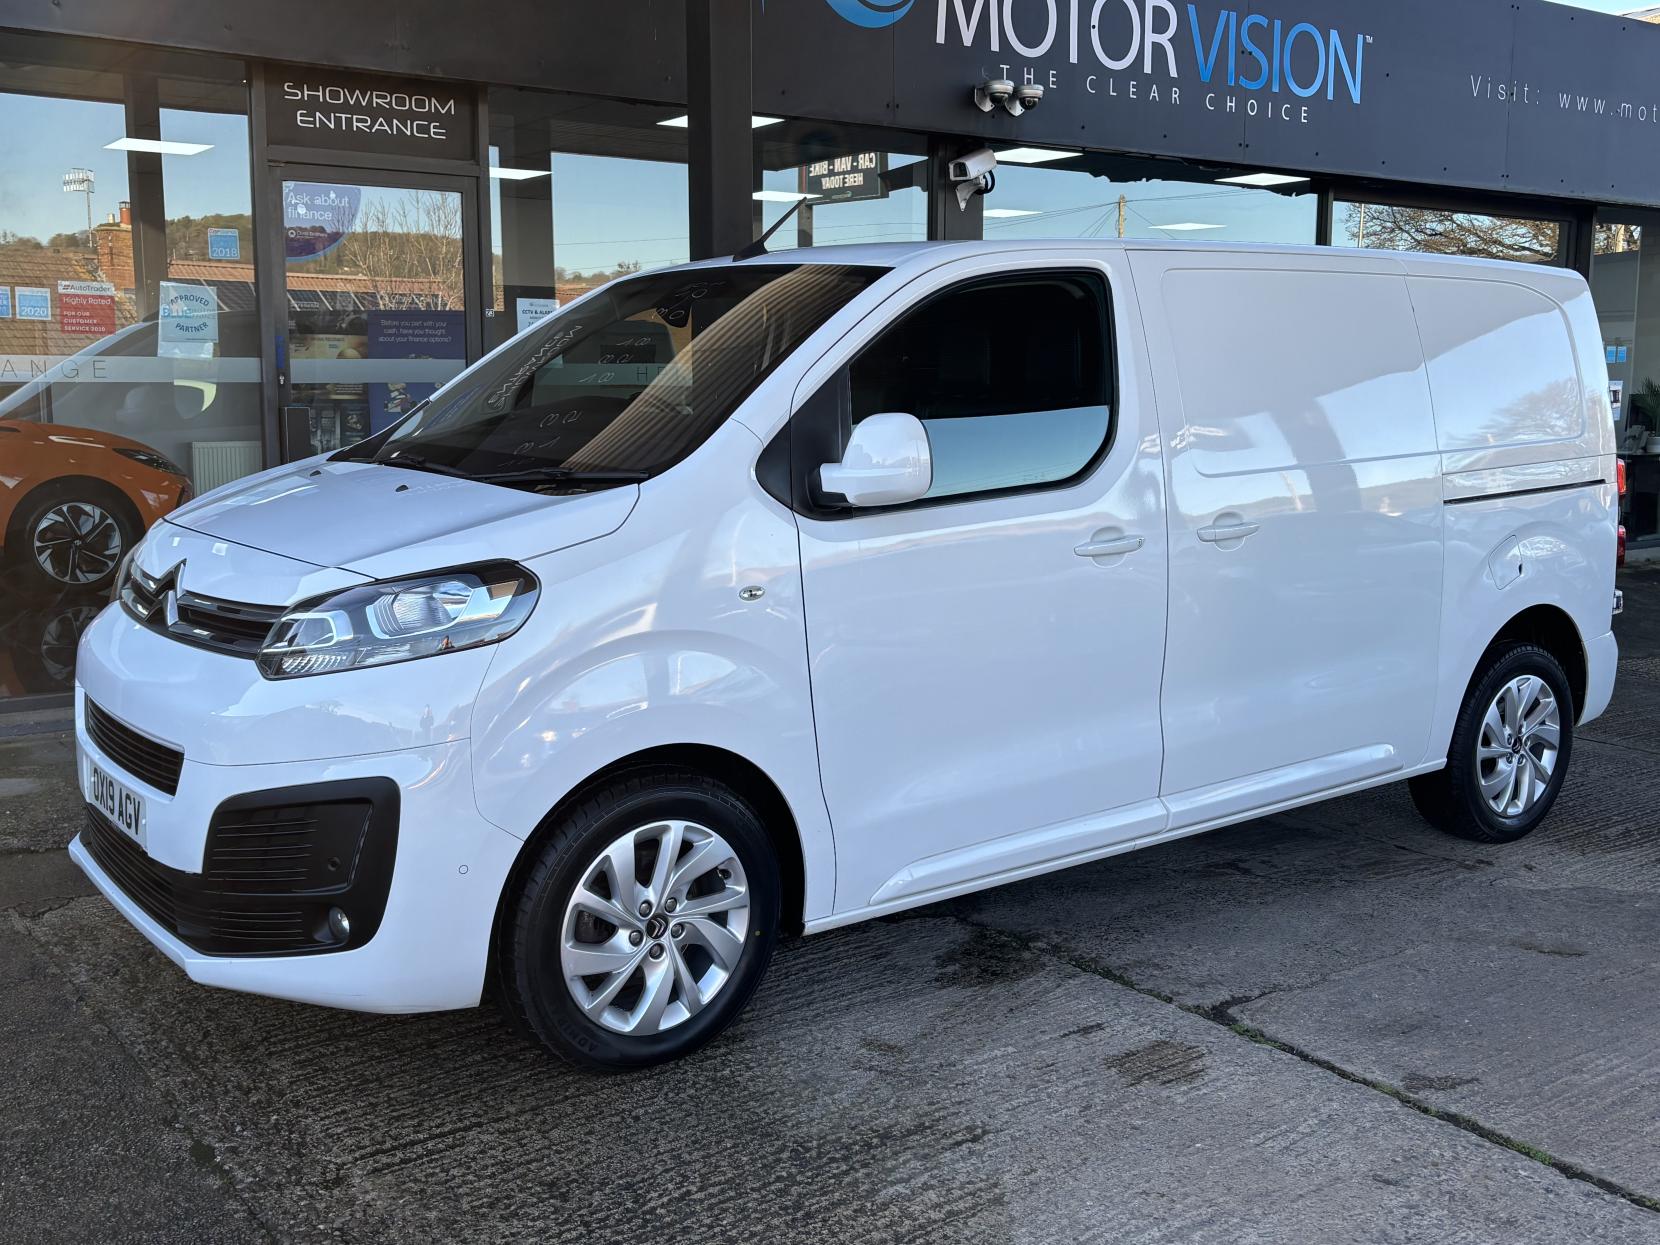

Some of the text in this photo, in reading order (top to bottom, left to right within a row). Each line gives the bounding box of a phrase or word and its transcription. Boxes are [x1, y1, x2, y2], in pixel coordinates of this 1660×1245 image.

[1000, 65, 1308, 123] THE CLEAR CHOICE
[1470, 75, 1540, 105] Visit:
[283, 82, 456, 115] SHOWROOM
[296, 110, 447, 139] ENTRANCE
[287, 192, 349, 207] Ask about
[287, 206, 332, 220] finance
[70, 284, 111, 292] AutoTrader
[63, 297, 87, 305] Highly
[170, 294, 209, 307] APPROVED
[21, 307, 47, 316] 2020
[175, 321, 209, 333] PARTNER
[93, 767, 140, 835] OX19 AGV
